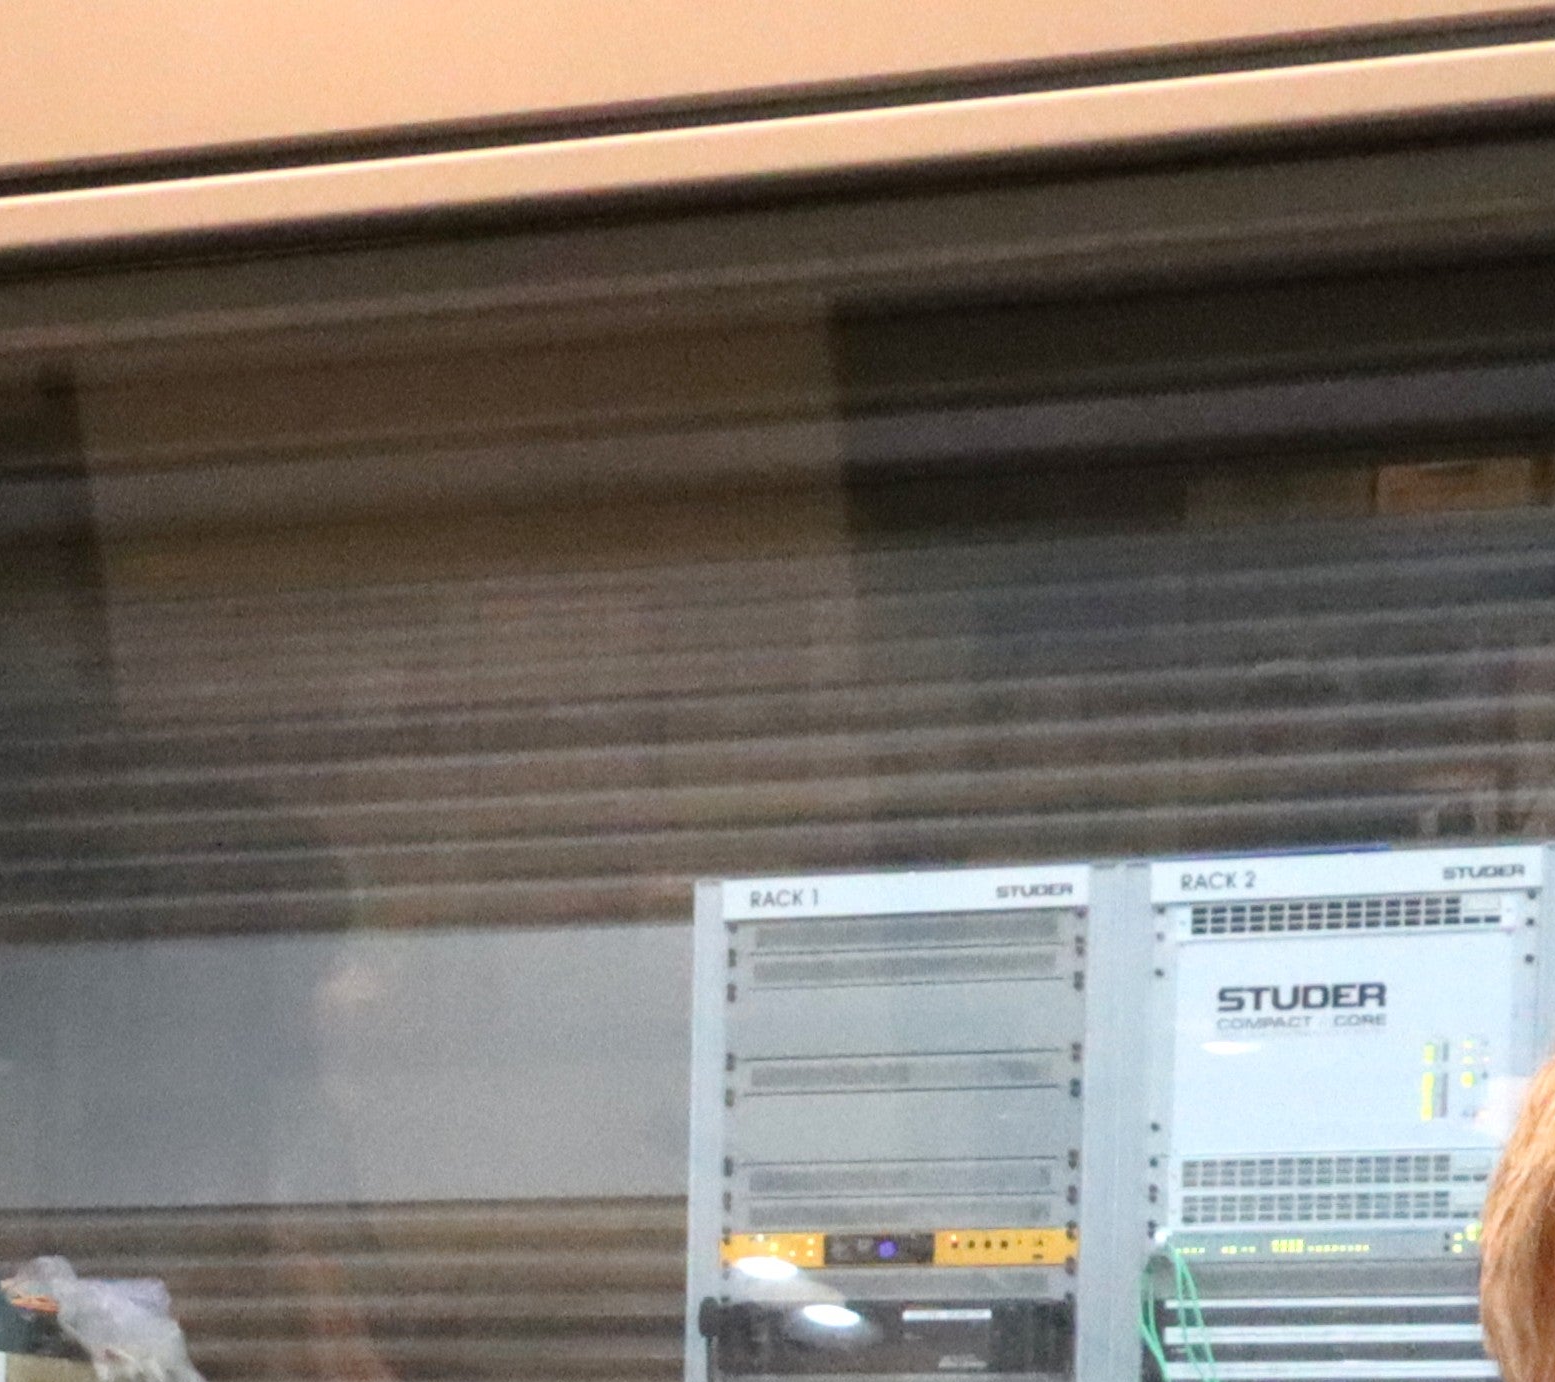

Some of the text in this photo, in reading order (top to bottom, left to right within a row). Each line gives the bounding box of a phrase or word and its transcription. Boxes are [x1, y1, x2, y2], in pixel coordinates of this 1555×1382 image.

[1181, 871, 1257, 891] RACK 2
[1442, 864, 1526, 880] STUDER
[749, 888, 819, 909] RACK 1
[996, 883, 1074, 899] STUDER
[1217, 982, 1387, 1012] STUDER
[1216, 1013, 1387, 1031] COMPACT CORE
